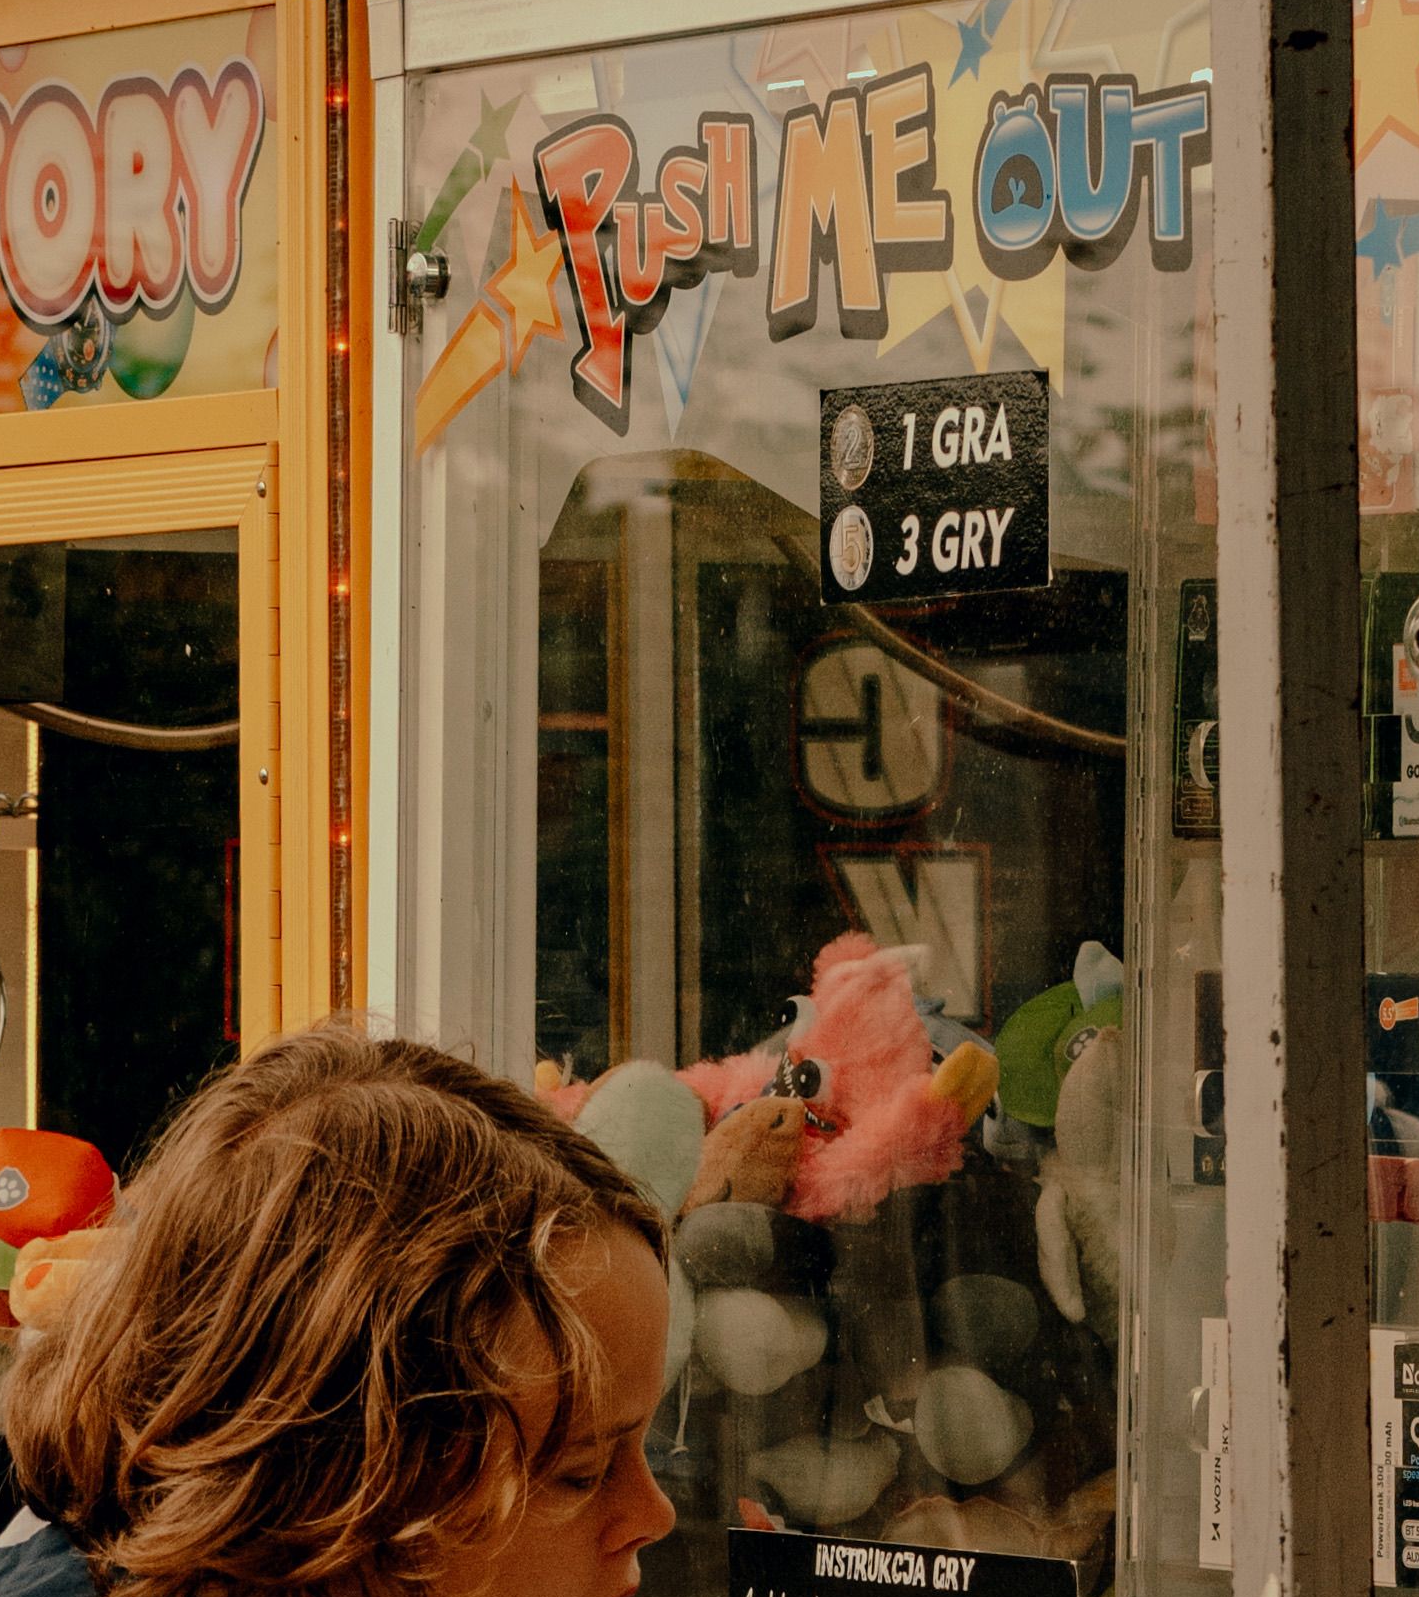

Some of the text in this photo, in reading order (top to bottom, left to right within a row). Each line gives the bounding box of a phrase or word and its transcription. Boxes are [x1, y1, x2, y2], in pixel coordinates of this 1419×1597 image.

[537, 67, 1210, 415] PUSH ME OUT
[902, 413, 917, 471] 1
[932, 403, 1013, 469] GRA
[895, 514, 921, 576] 3
[932, 507, 1016, 573] GRY
[815, 1543, 976, 1592] INSTRUKCJA GRY
